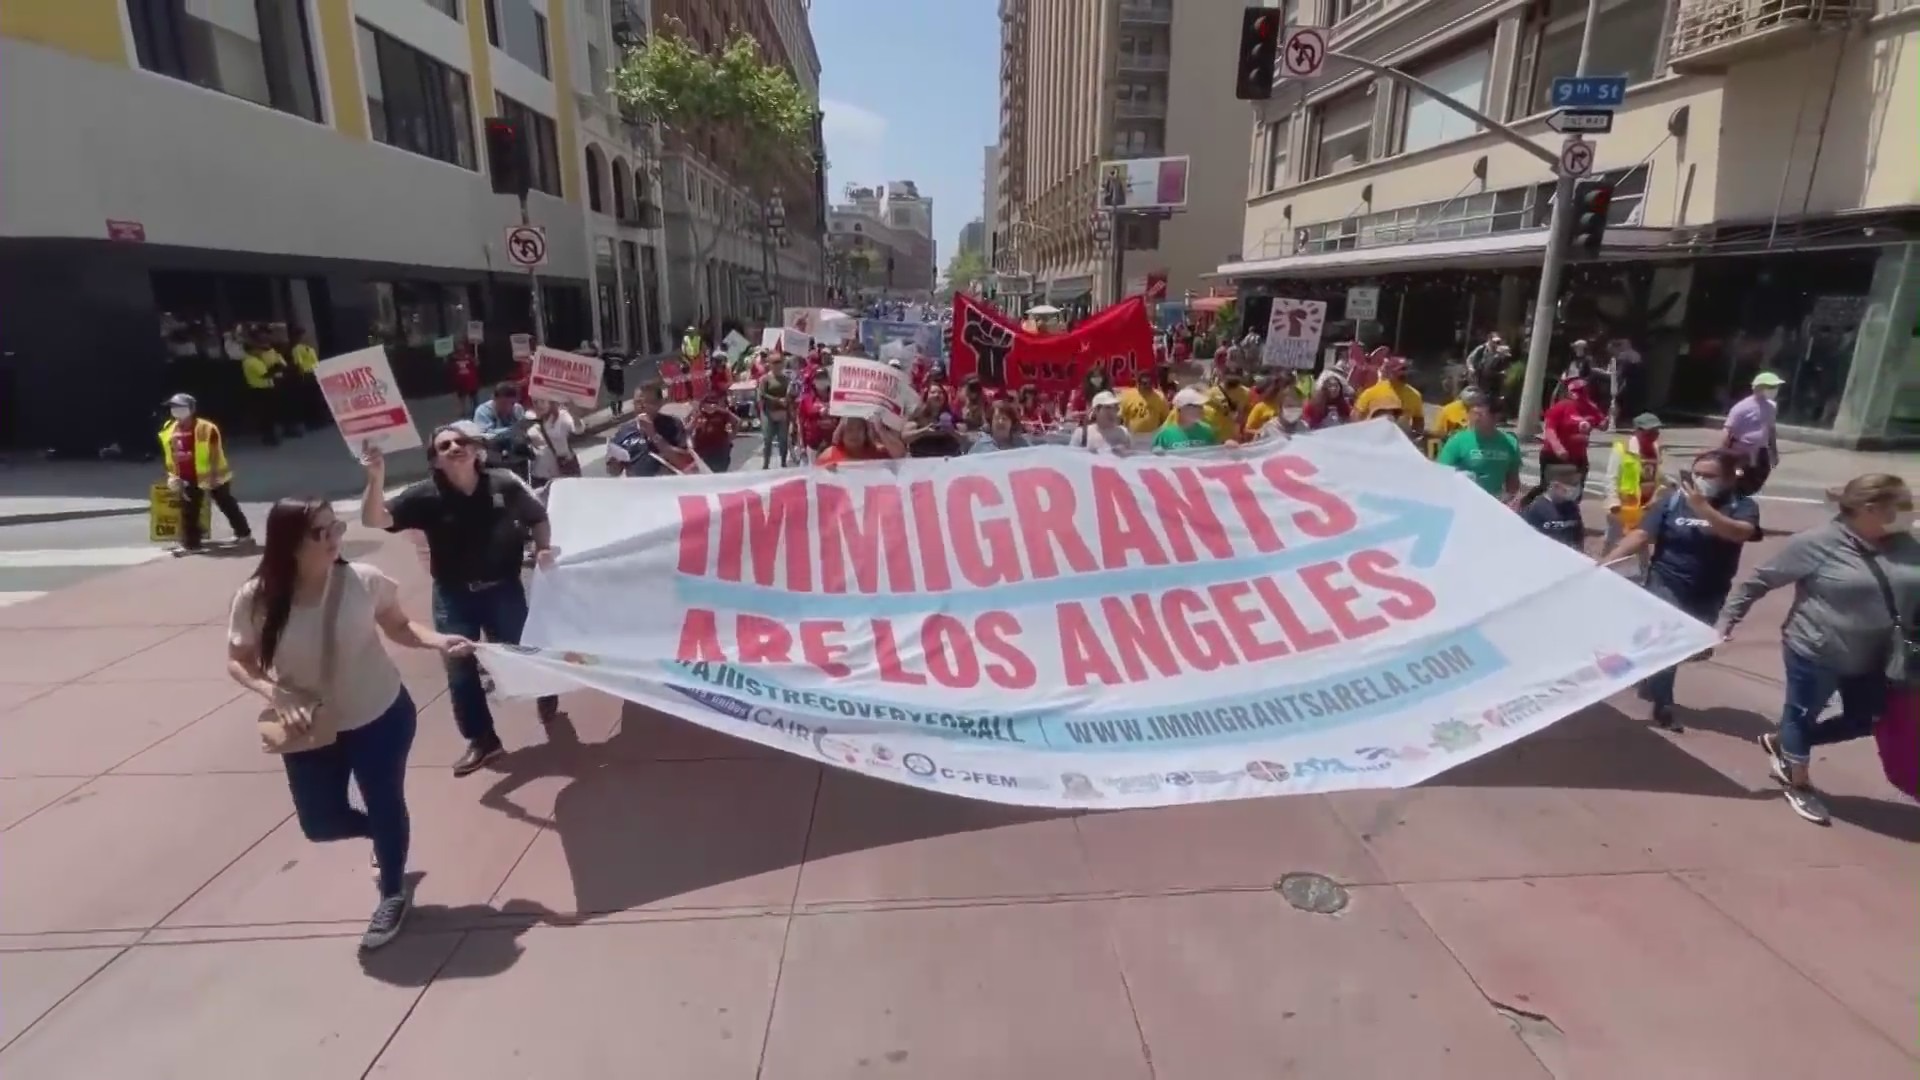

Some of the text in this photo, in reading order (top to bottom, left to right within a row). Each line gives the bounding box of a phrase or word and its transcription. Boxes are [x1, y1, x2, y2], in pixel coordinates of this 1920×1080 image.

[1558, 82, 1619, 101] 9th St
[677, 454, 1357, 594] IMMIGRANTS
[677, 549, 1437, 690] ARE LOS ANGELES
[1066, 644, 1476, 745] WWW.IMMIGRANTSARELA.COM
